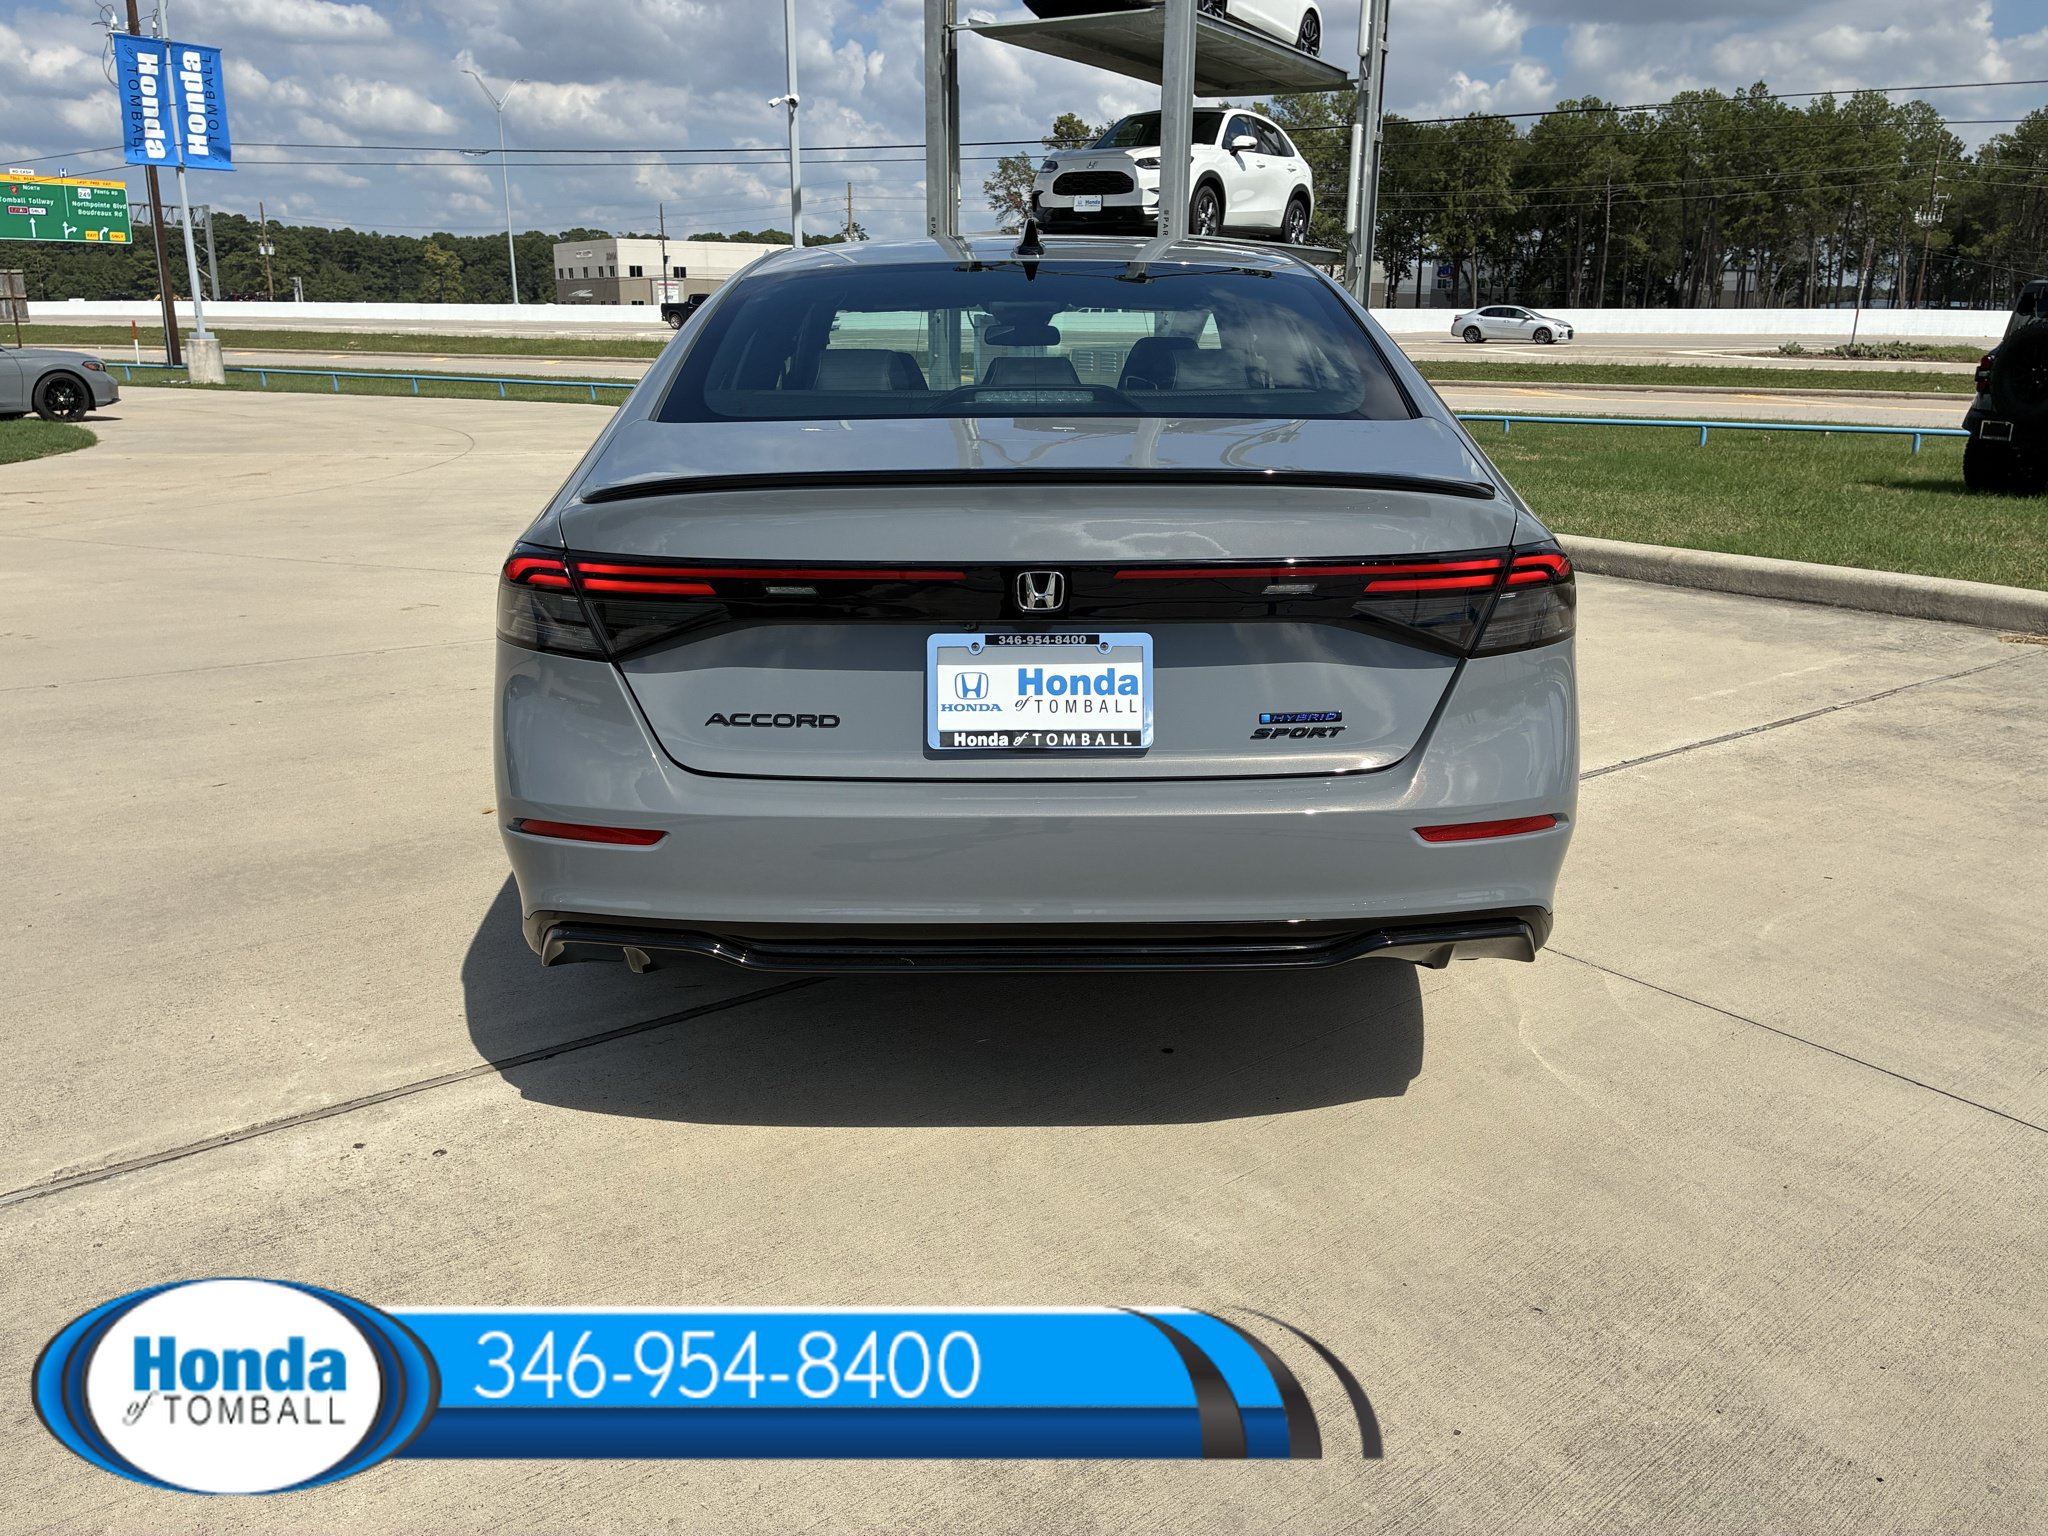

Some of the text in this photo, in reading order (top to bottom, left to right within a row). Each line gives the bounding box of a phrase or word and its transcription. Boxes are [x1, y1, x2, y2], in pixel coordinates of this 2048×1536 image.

[137, 52, 166, 159] Honda
[180, 51, 209, 156] Honda
[202, 55, 220, 142] TOMBALL
[127, 67, 146, 157] TOMBALL
[28, 197, 54, 207] Tollway
[72, 201, 110, 209] Northpointe
[998, 635, 1087, 645] 346-954-8400
[1018, 667, 1139, 696] Honda
[941, 703, 1003, 712] HONDA
[1015, 695, 1138, 714] of TOMBALL
[704, 712, 841, 728] ACCORD
[1272, 712, 1338, 723] HYBRID
[954, 732, 1009, 747] Honda
[1034, 733, 1133, 746] TOMBALL
[1250, 725, 1348, 740] SPORT
